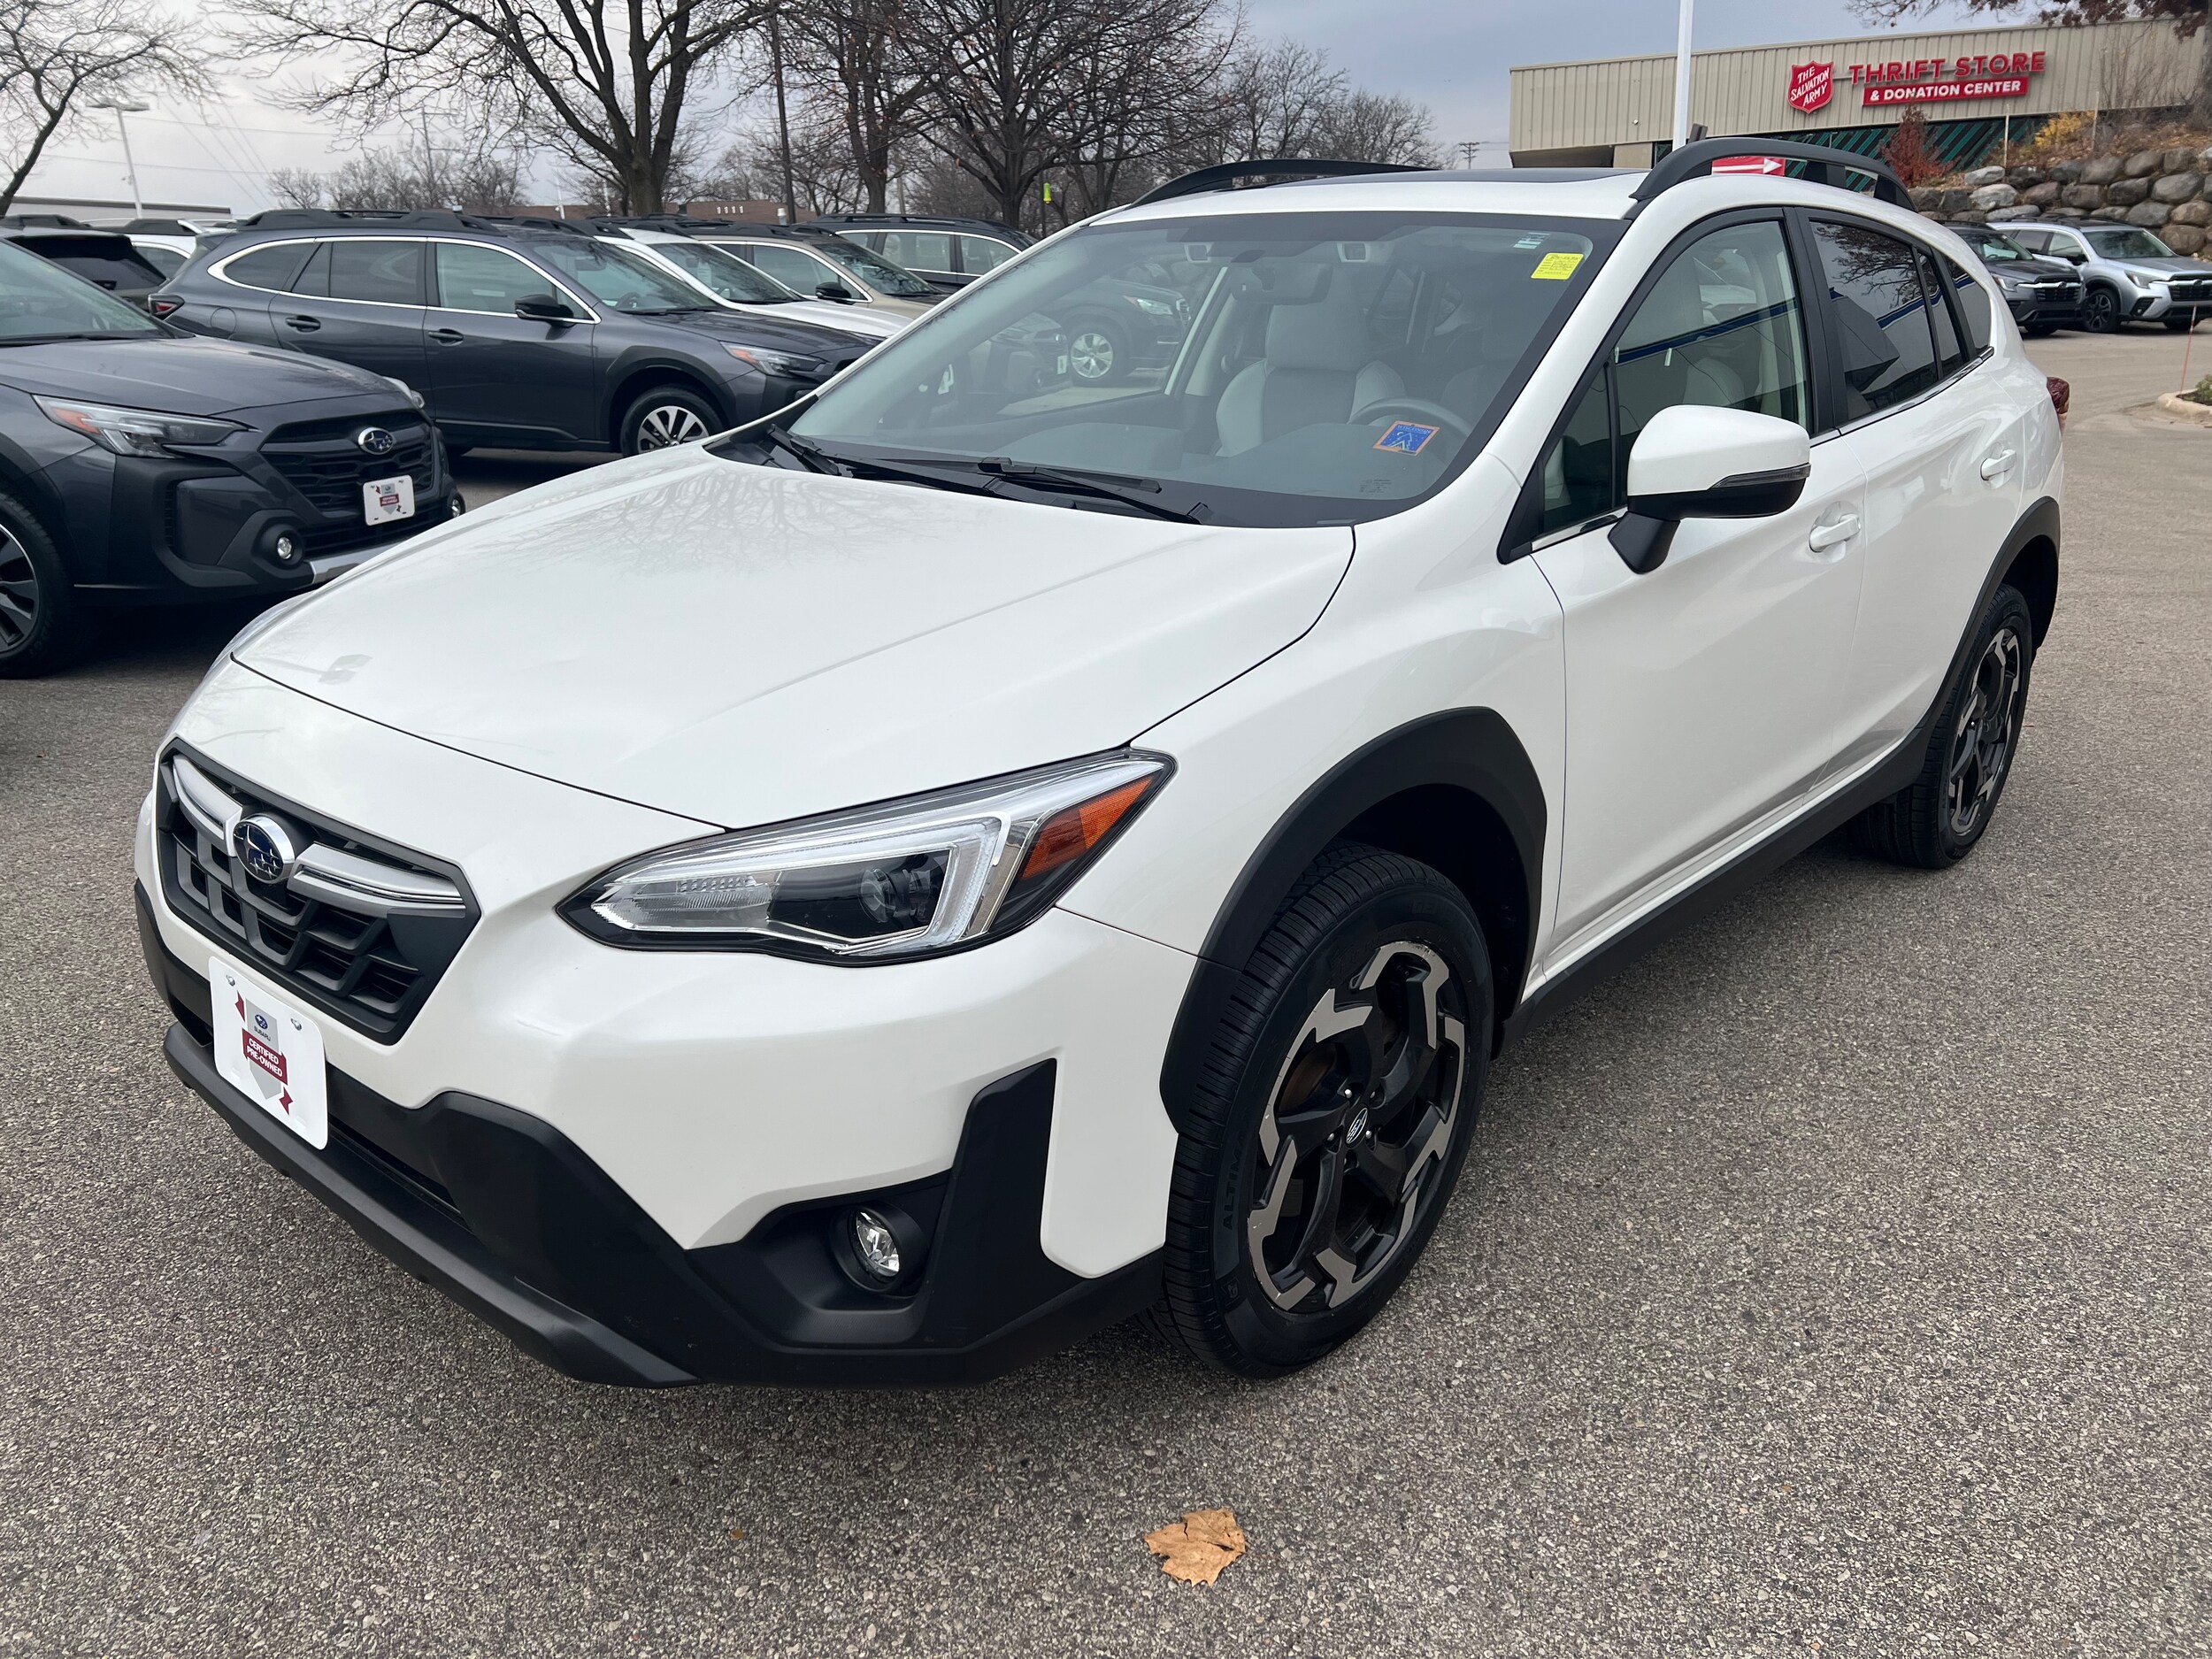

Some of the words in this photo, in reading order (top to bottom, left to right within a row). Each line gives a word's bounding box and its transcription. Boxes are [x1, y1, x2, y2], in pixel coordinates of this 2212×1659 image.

[1797, 66, 1816, 84] THE
[1849, 58, 1946, 85] THRIFT
[1955, 50, 2046, 78] STORE
[1790, 67, 1830, 101] SALVATION
[1802, 81, 1827, 107] ARMY
[1870, 91, 1880, 101] &
[1884, 82, 1960, 101] DONATION
[1963, 80, 2021, 95] CENTER
[717, 205, 744, 215] 1111
[254, 1025, 271, 1041] SUBARU
[247, 1045, 283, 1078] PRE-OWNED
[249, 1038, 279, 1065] CERTIFIED
